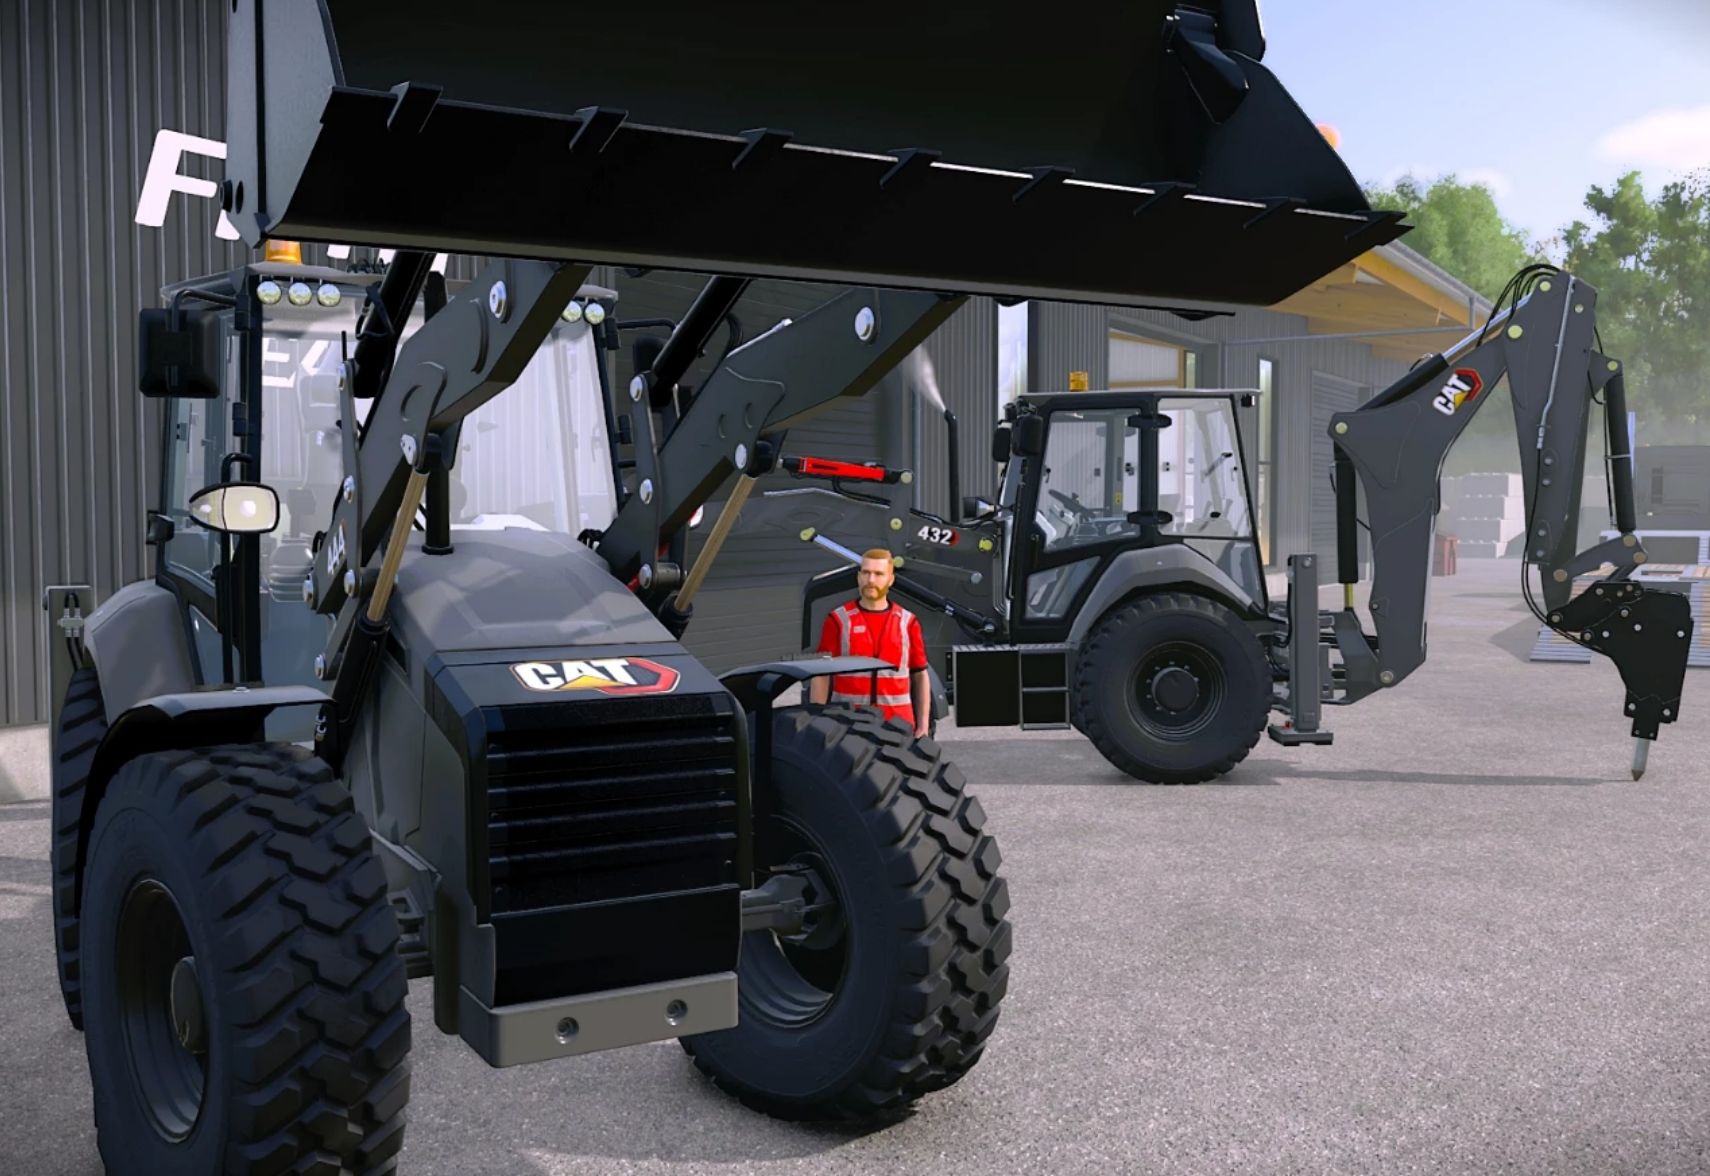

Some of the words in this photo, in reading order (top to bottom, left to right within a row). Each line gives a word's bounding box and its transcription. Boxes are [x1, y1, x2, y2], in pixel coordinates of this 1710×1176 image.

[1433, 373, 1472, 415] CAT
[917, 525, 953, 545] 432
[514, 658, 638, 690] CAT
